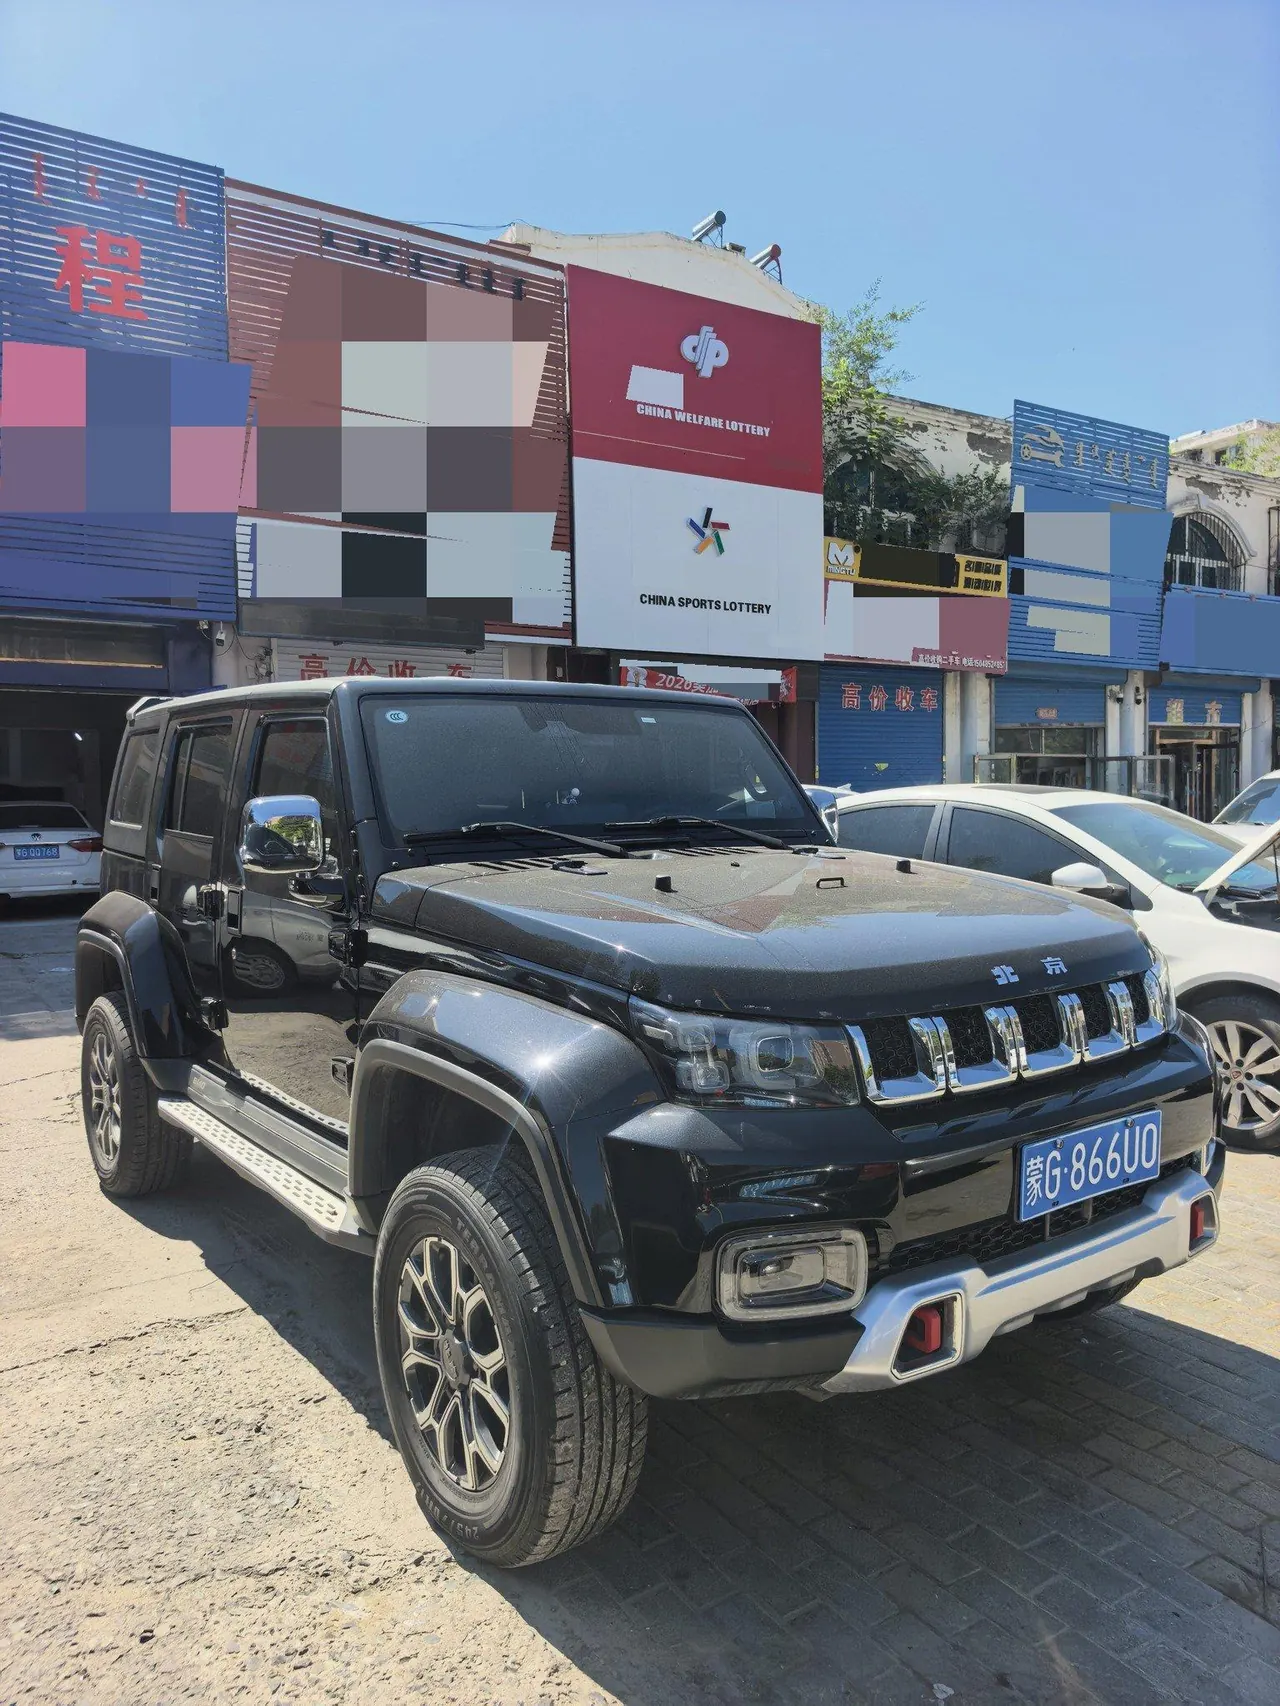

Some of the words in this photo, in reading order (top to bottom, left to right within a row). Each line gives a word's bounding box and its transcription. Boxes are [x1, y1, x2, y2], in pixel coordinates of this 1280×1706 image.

[55, 226, 149, 320] 程
[636, 403, 673, 420] CHINA
[674, 410, 724, 429] WELFARE
[725, 420, 770, 437] LOTTERY
[640, 593, 675, 607] CHINA
[678, 596, 722, 611] SPORTS
[723, 601, 771, 614] LOTTERY
[841, 682, 938, 713] 高价收车
[990, 956, 1068, 985] 北京
